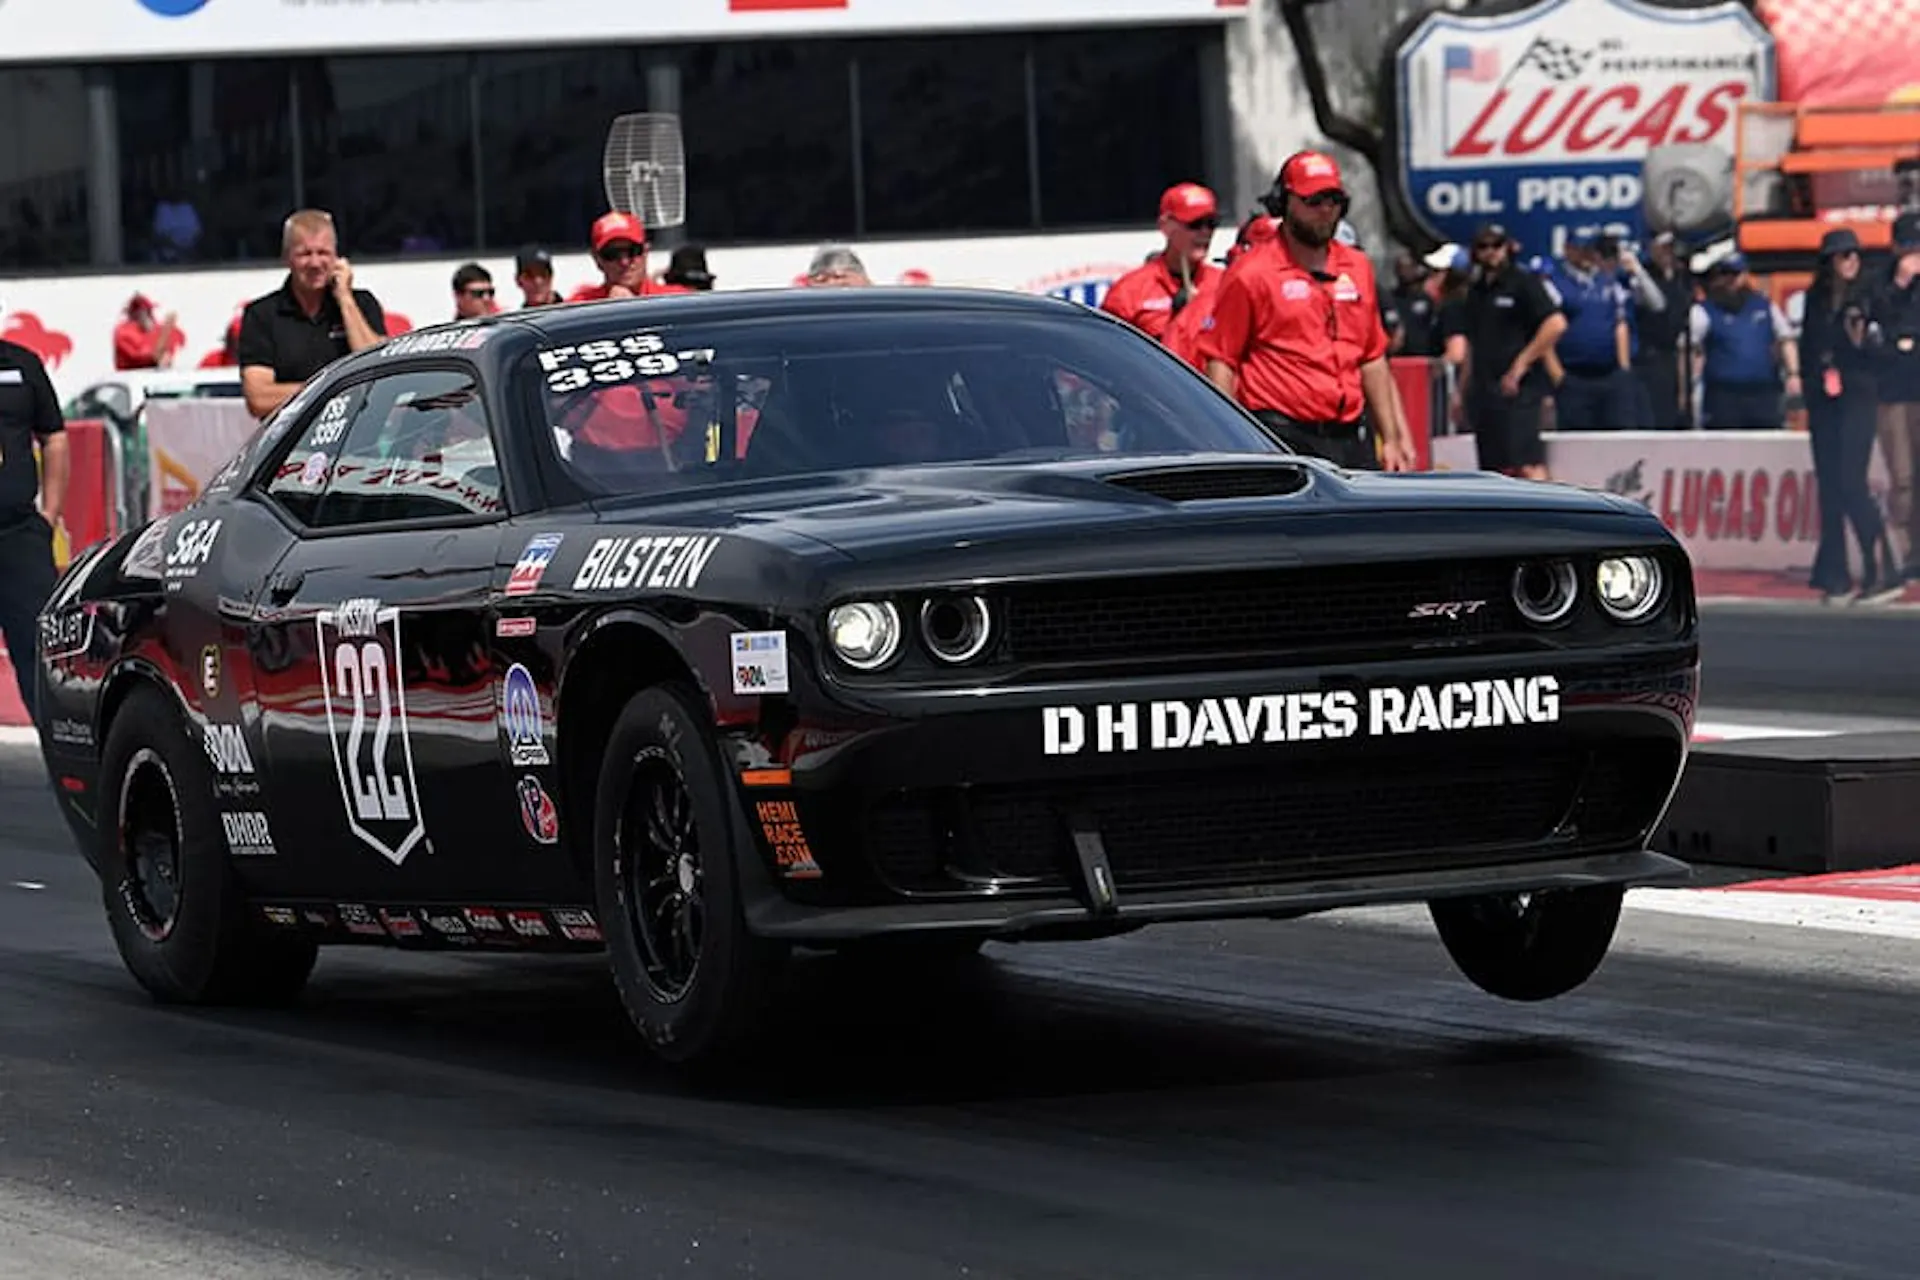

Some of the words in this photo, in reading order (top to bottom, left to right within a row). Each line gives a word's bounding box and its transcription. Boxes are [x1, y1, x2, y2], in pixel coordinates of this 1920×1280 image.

[1446, 81, 1747, 157] LUCAS
[1427, 180, 1503, 214] OIL
[538, 334, 665, 372] FSS
[1661, 469, 1770, 542] LUCAS
[572, 536, 721, 590] BILSTEIN
[1406, 600, 1486, 620] SRT
[335, 642, 411, 820] 22
[1043, 705, 1085, 754] D
[1096, 703, 1138, 752] H
[1150, 690, 1358, 749] DAVIES
[1368, 675, 1559, 735] RACING
[220, 811, 273, 845] DHDR
[763, 823, 806, 844] RACE
